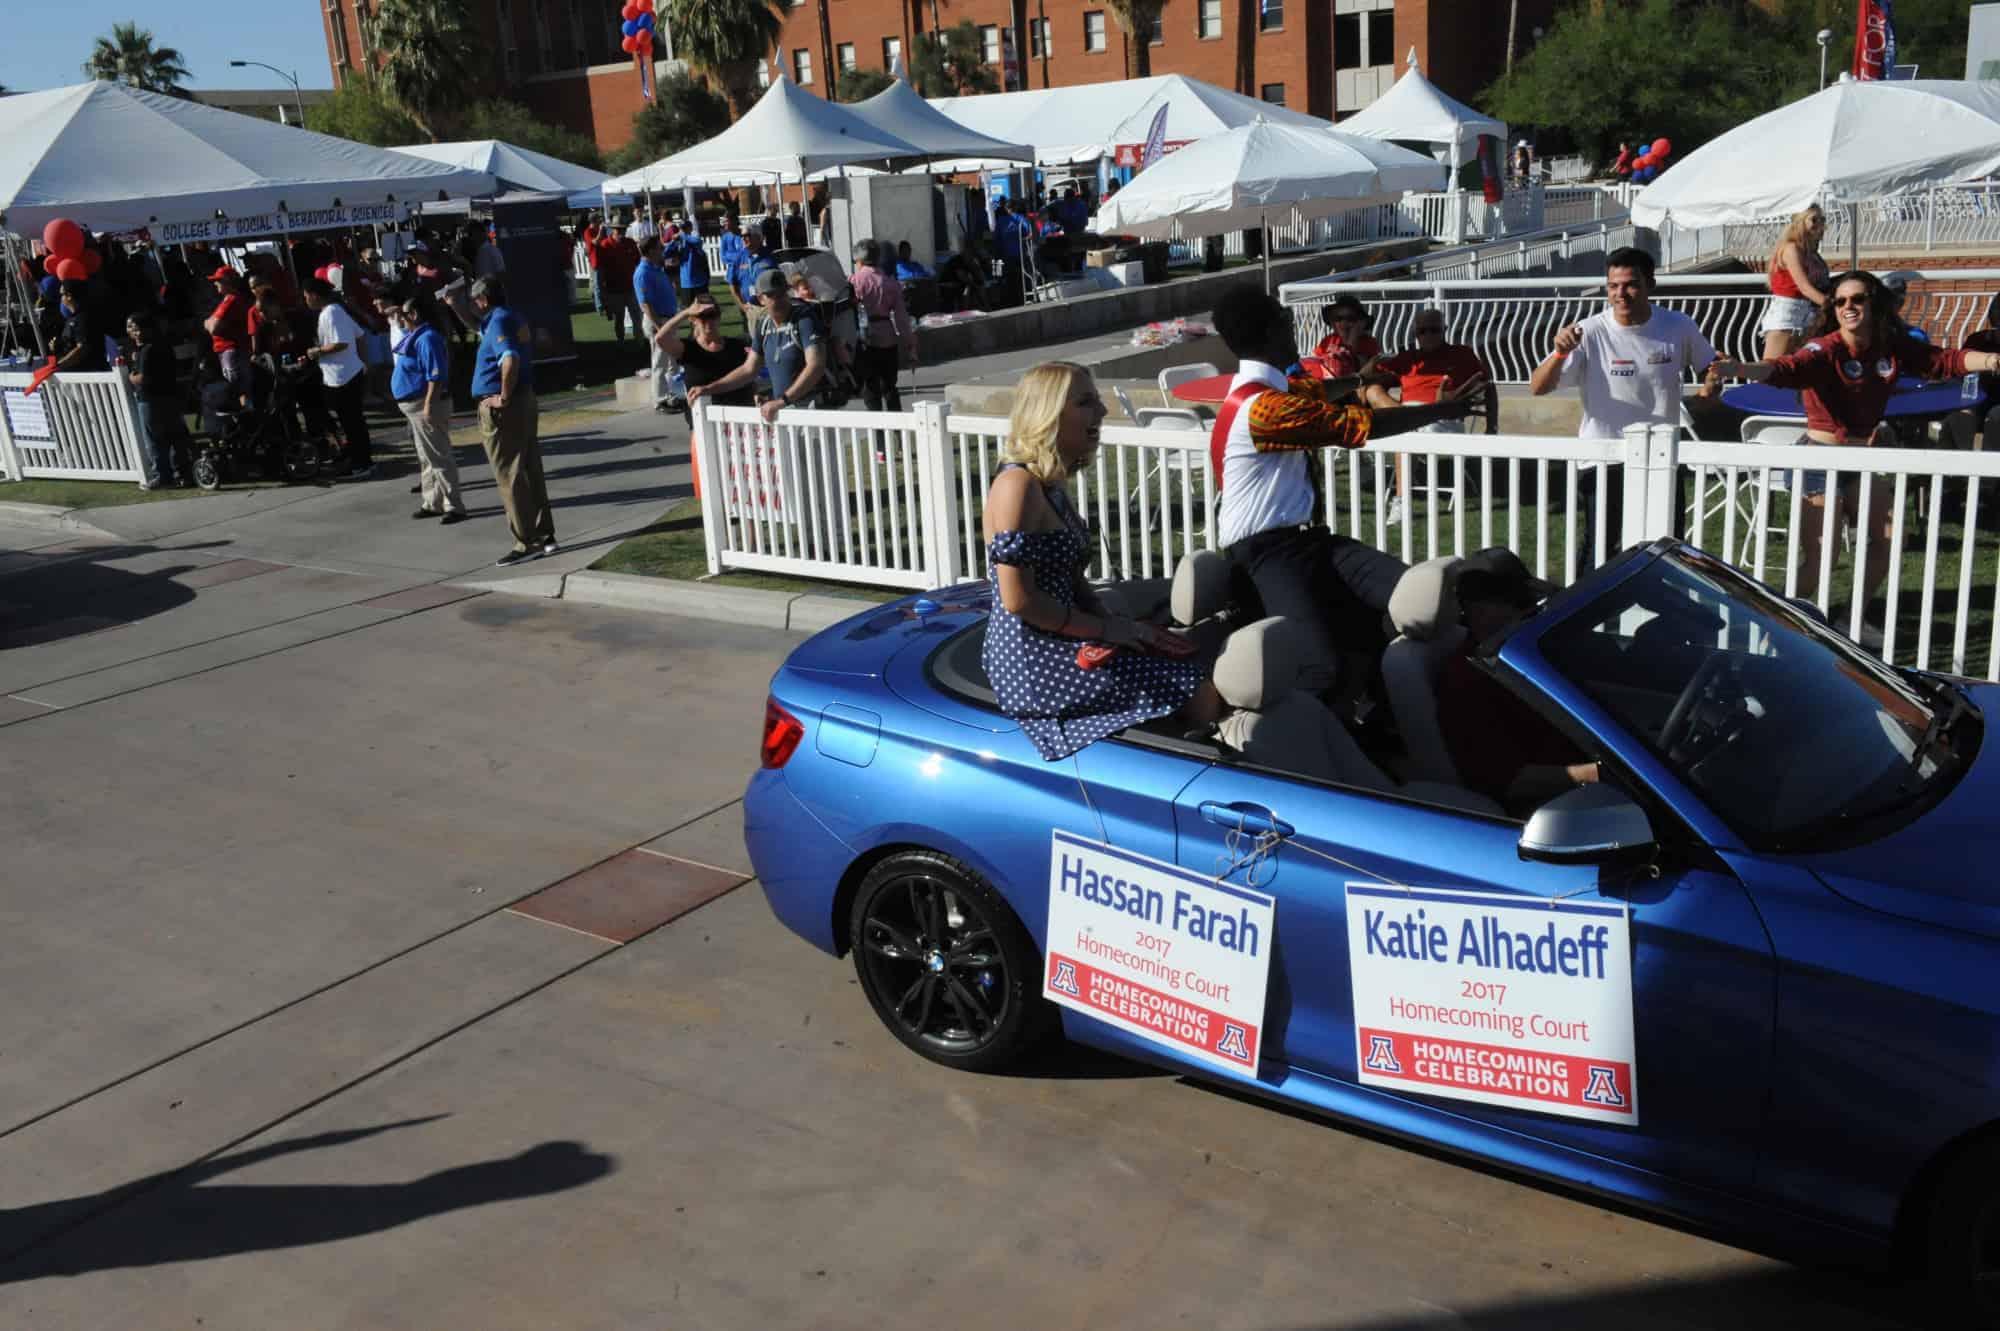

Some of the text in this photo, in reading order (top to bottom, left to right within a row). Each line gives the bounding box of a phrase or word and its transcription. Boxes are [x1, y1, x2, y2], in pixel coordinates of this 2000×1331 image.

[163, 221, 210, 240] COLLEGE
[216, 220, 231, 235] OF
[236, 214, 272, 233] SOCIAL
[288, 208, 347, 228] BEHAVIORAL
[352, 205, 394, 220] SCIENCES
[1060, 853, 1259, 957] Hassan Farah
[1136, 931, 1171, 958] 2017
[1364, 908, 1609, 979] Katie Alhadeff
[1076, 931, 1231, 1003] Homecoming Court
[1090, 972, 1209, 1029] HOMECOMING
[1460, 981, 1507, 1005] 2017
[1089, 989, 1208, 1045] CELEBRATION
[1390, 997, 1589, 1042] Homecoming Court
[1412, 1041, 1568, 1079] HOMECOMING
[1414, 1060, 1569, 1098] CELEBRATION
